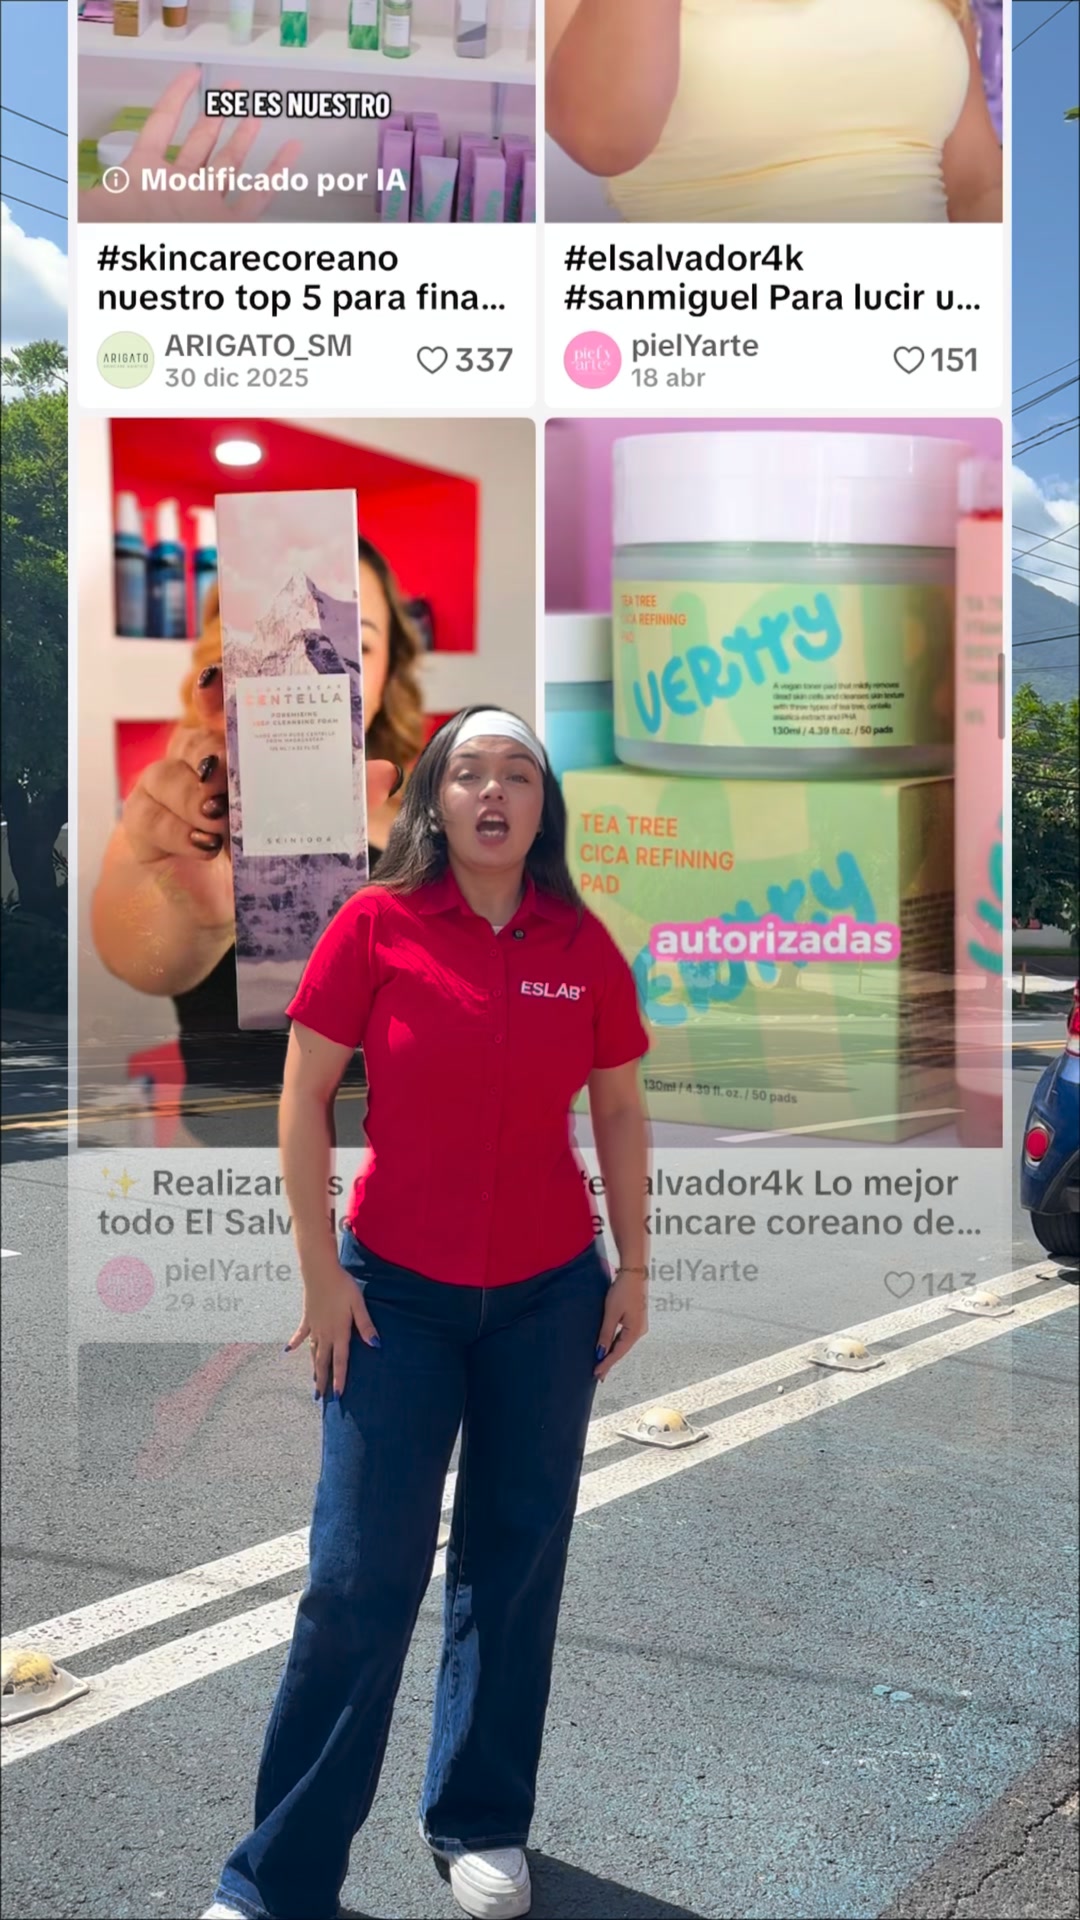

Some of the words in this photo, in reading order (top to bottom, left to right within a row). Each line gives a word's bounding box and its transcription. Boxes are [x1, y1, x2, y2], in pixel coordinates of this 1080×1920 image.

[635, 594, 657, 607] TREE
[639, 613, 688, 625] REFINING
[773, 726, 801, 735] 130ml
[808, 726, 830, 735] 4.39
[860, 726, 872, 735] 50
[873, 725, 894, 736] pads
[581, 813, 620, 835] TEA
[627, 816, 678, 838] TREE
[580, 843, 629, 865] CICA
[636, 846, 734, 872] REFINING
[580, 873, 620, 894] PAD
[644, 1079, 676, 1092] 130ml
[752, 1090, 767, 1101] 50
[769, 1092, 798, 1104] pads
